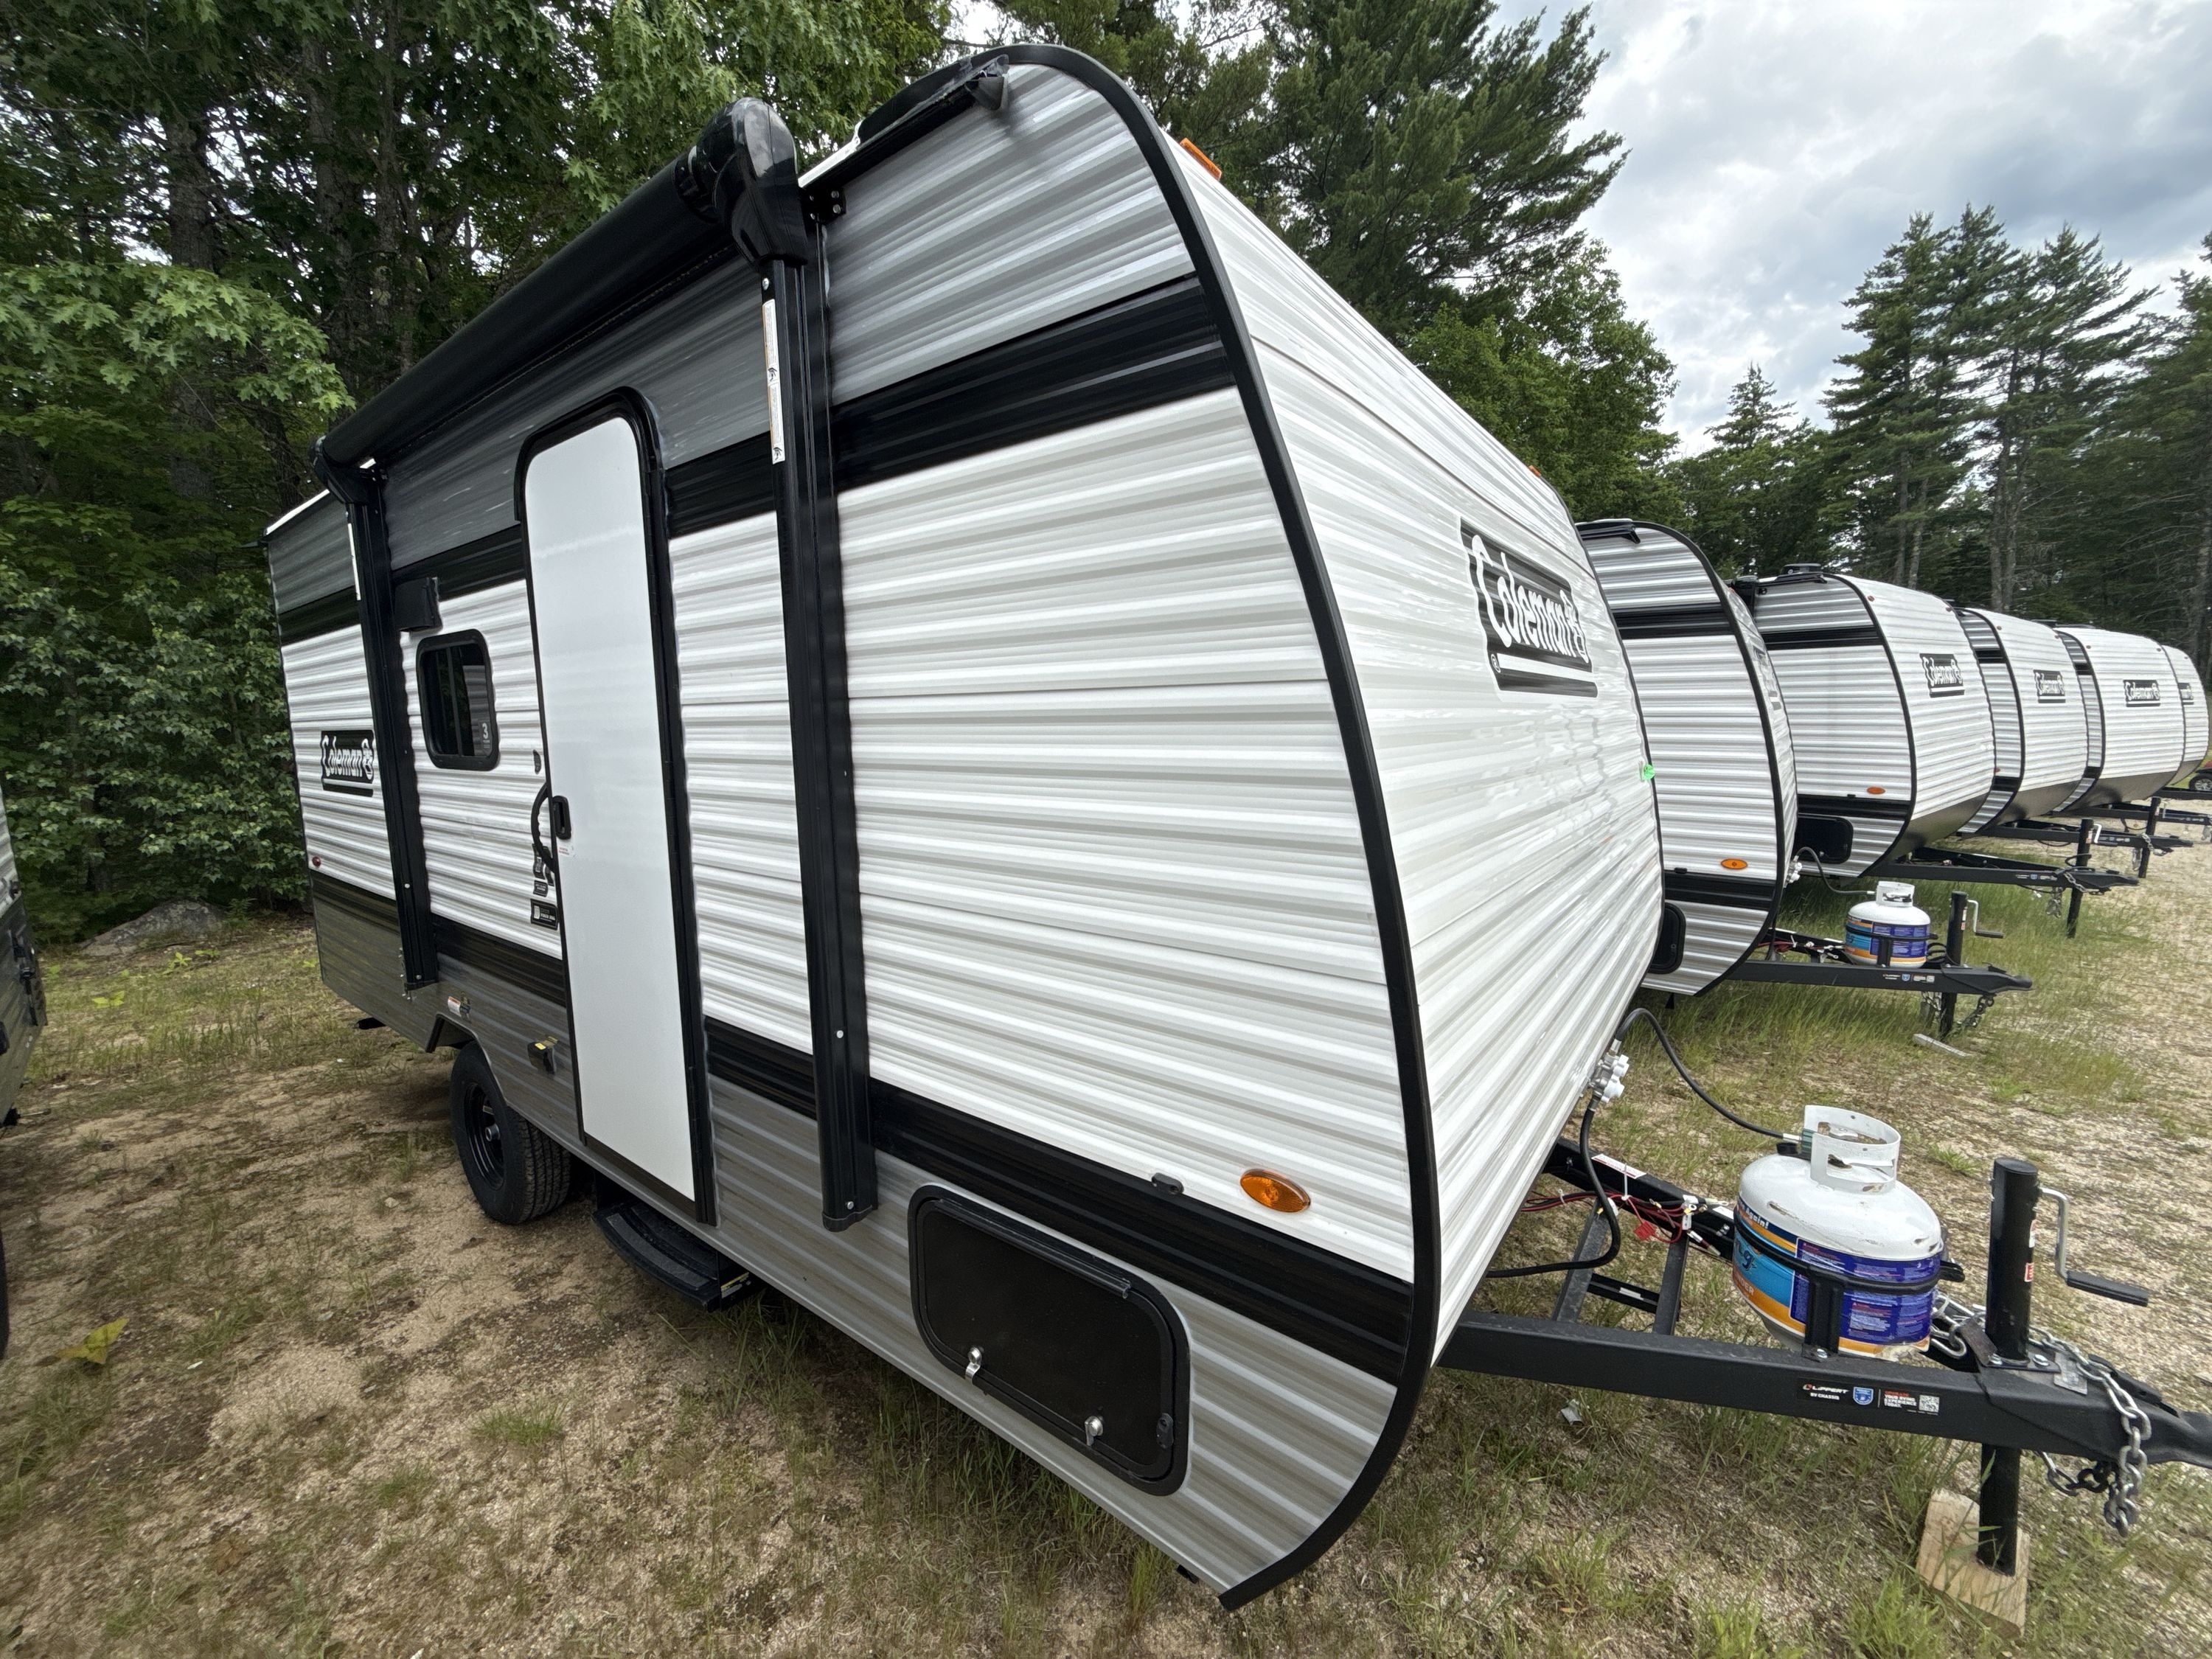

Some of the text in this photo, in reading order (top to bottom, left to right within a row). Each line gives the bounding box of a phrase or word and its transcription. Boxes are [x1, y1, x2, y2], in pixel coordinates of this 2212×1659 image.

[1472, 535, 1576, 658] Coleman
[1922, 656, 1957, 686] Coleman
[322, 735, 363, 777] Coleman
